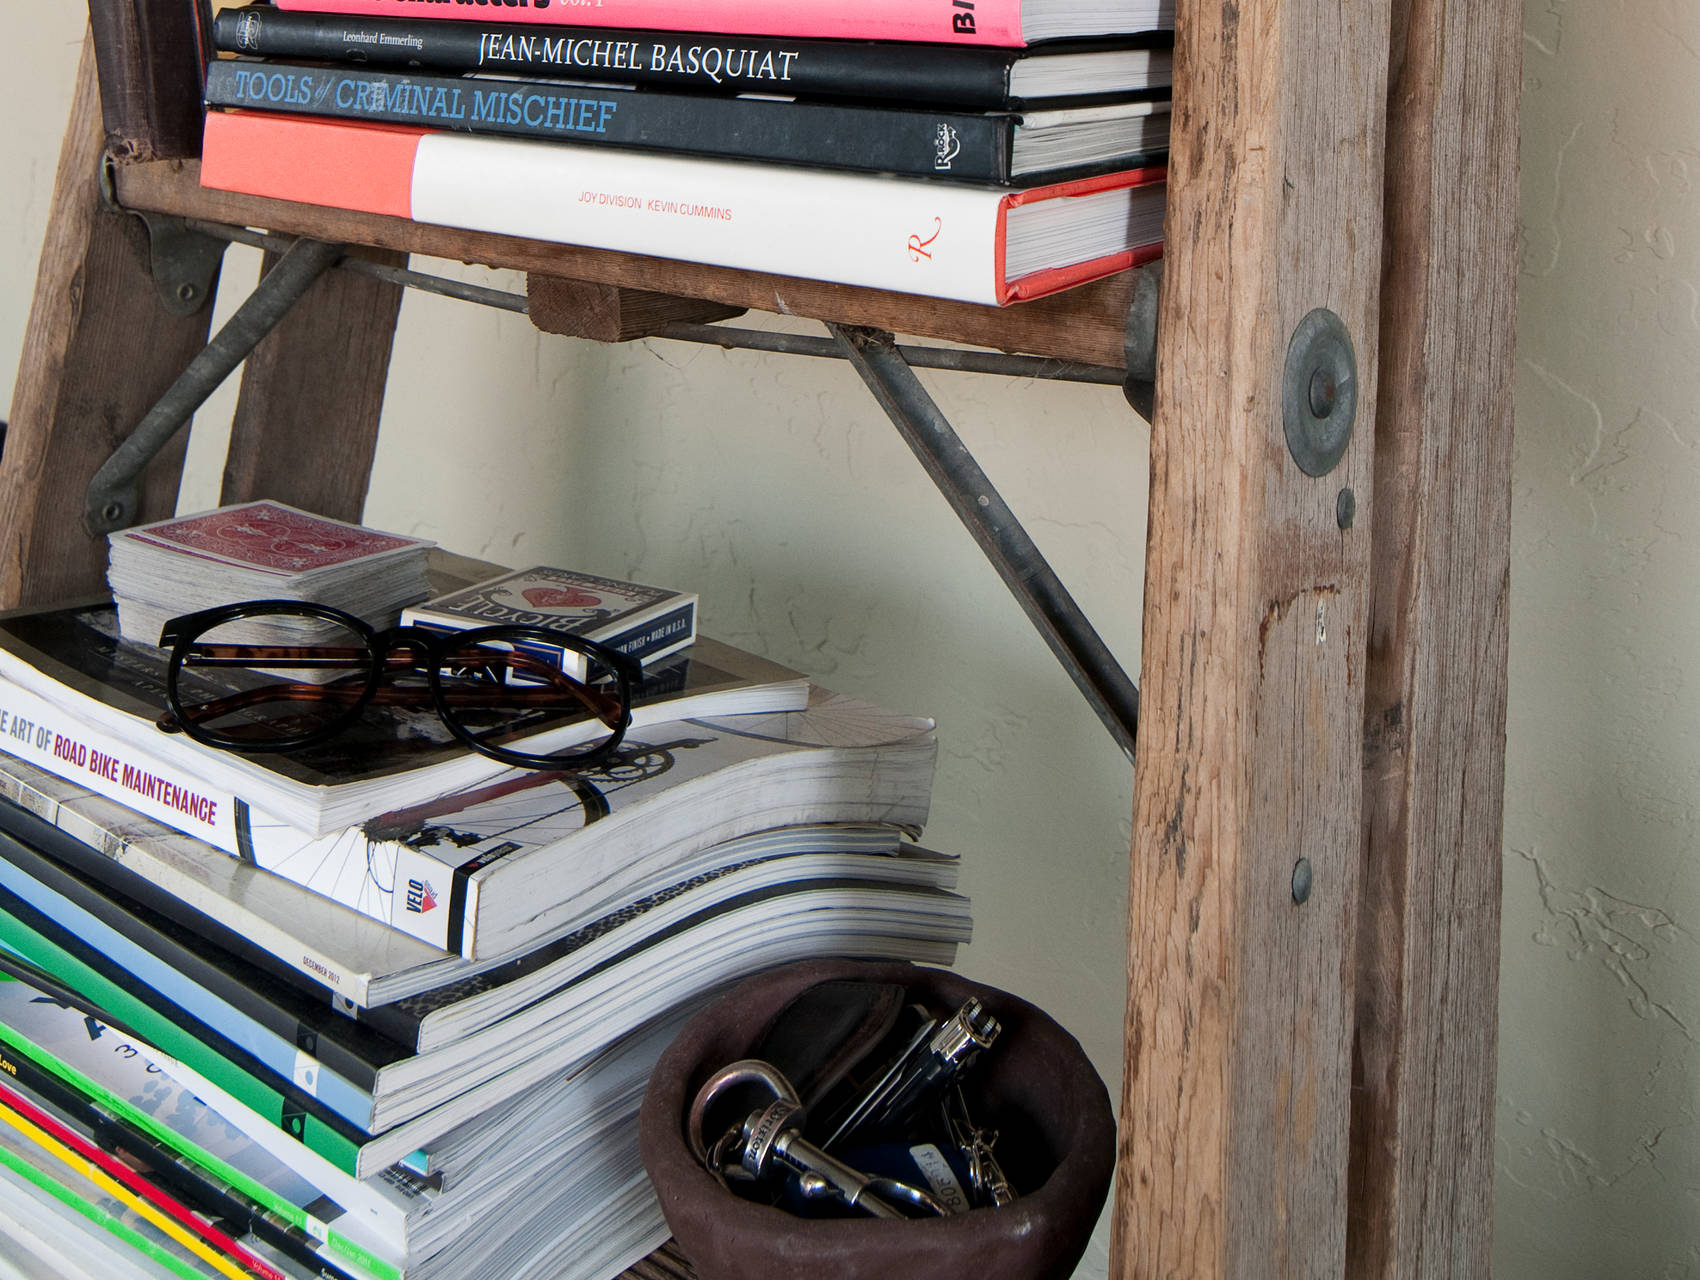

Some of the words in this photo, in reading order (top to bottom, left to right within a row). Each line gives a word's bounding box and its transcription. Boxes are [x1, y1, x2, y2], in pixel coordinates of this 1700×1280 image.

[343, 30, 378, 45] Leonhard
[379, 33, 424, 50] Emmerling
[478, 32, 643, 71] JEAN-MICHEL
[650, 43, 799, 84] BASQUIAT
[235, 70, 313, 105] TOOLS
[314, 76, 336, 109] of
[336, 79, 466, 120] CRIMINAL
[471, 90, 617, 133] MISCHIEF
[578, 191, 597, 206] JOY
[599, 192, 642, 209] DIVISION
[647, 199, 678, 215] KEVIN
[679, 203, 733, 222] CUMMINS
[908, 216, 942, 263] R
[447, 594, 592, 633] BICYCLE
[650, 627, 665, 643] MADE
[9, 716, 35, 745] ART
[36, 726, 52, 751] OF
[54, 734, 87, 768] ROAD
[89, 750, 120, 782] BIKE
[121, 763, 217, 825] MAINTENANCE
[406, 878, 424, 913] VELO
